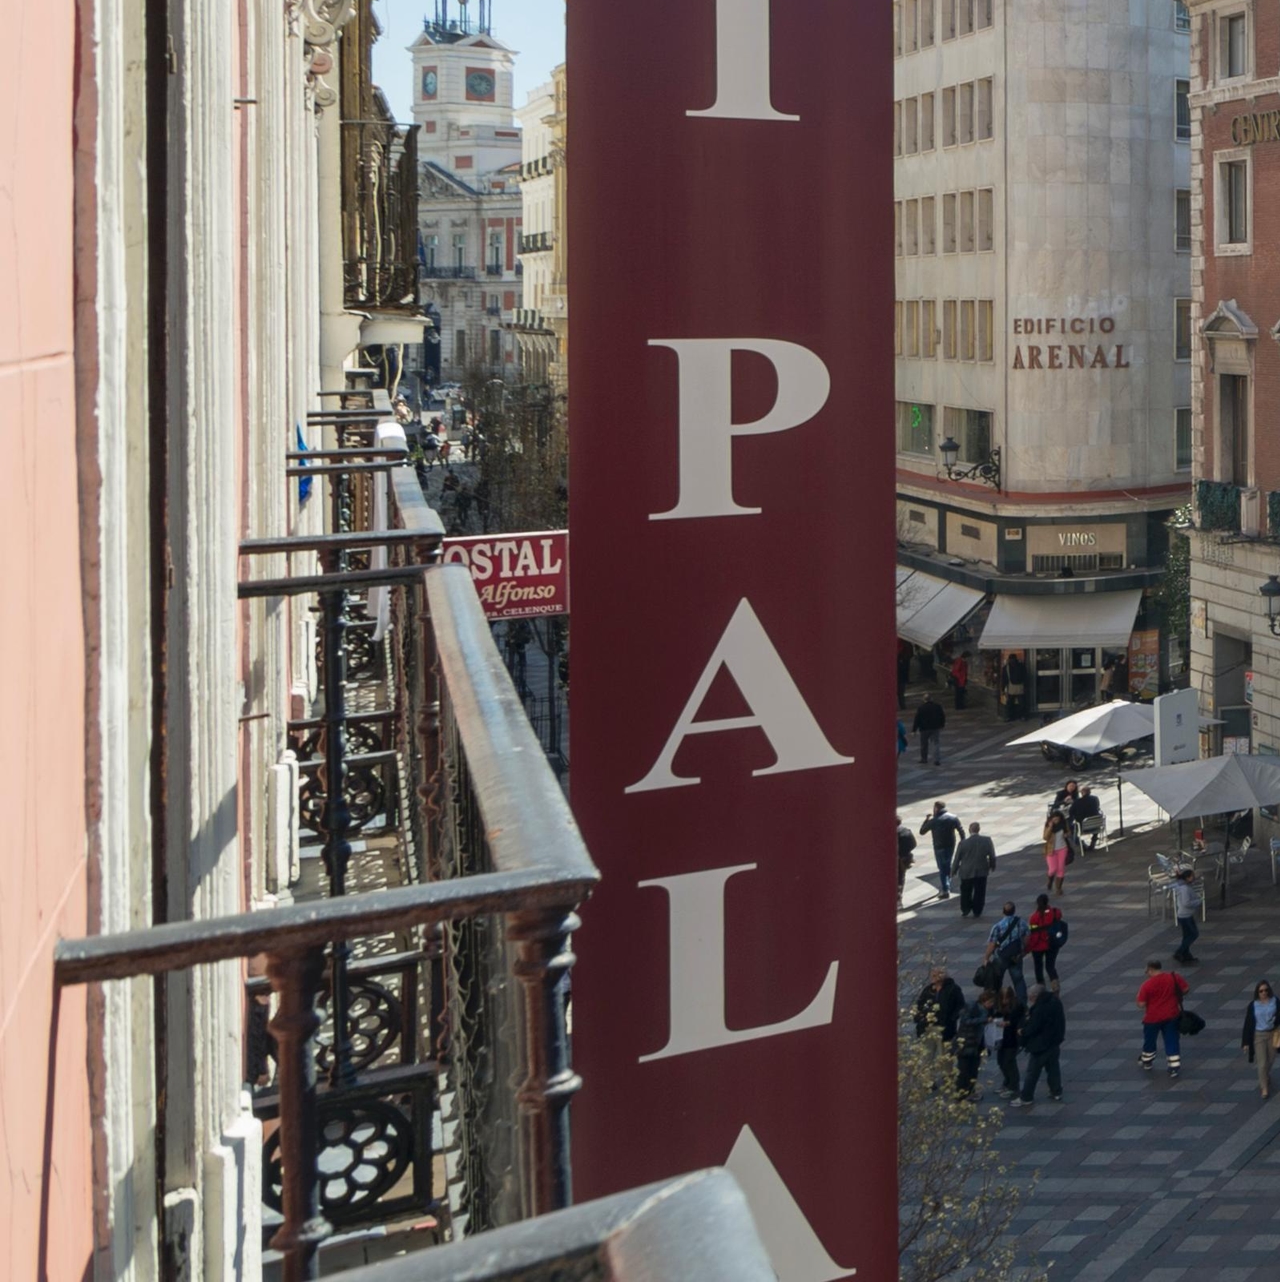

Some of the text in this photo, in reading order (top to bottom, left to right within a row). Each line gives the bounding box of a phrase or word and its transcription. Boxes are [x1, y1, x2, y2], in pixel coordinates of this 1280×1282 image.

[1013, 316, 1115, 335] EDIFICIO
[1012, 344, 1130, 370] ARENAL
[1058, 531, 1097, 546] VINOS
[437, 539, 562, 580] OSTAL
[480, 581, 556, 609] Alfonso
[503, 603, 564, 617] CELENQUE
